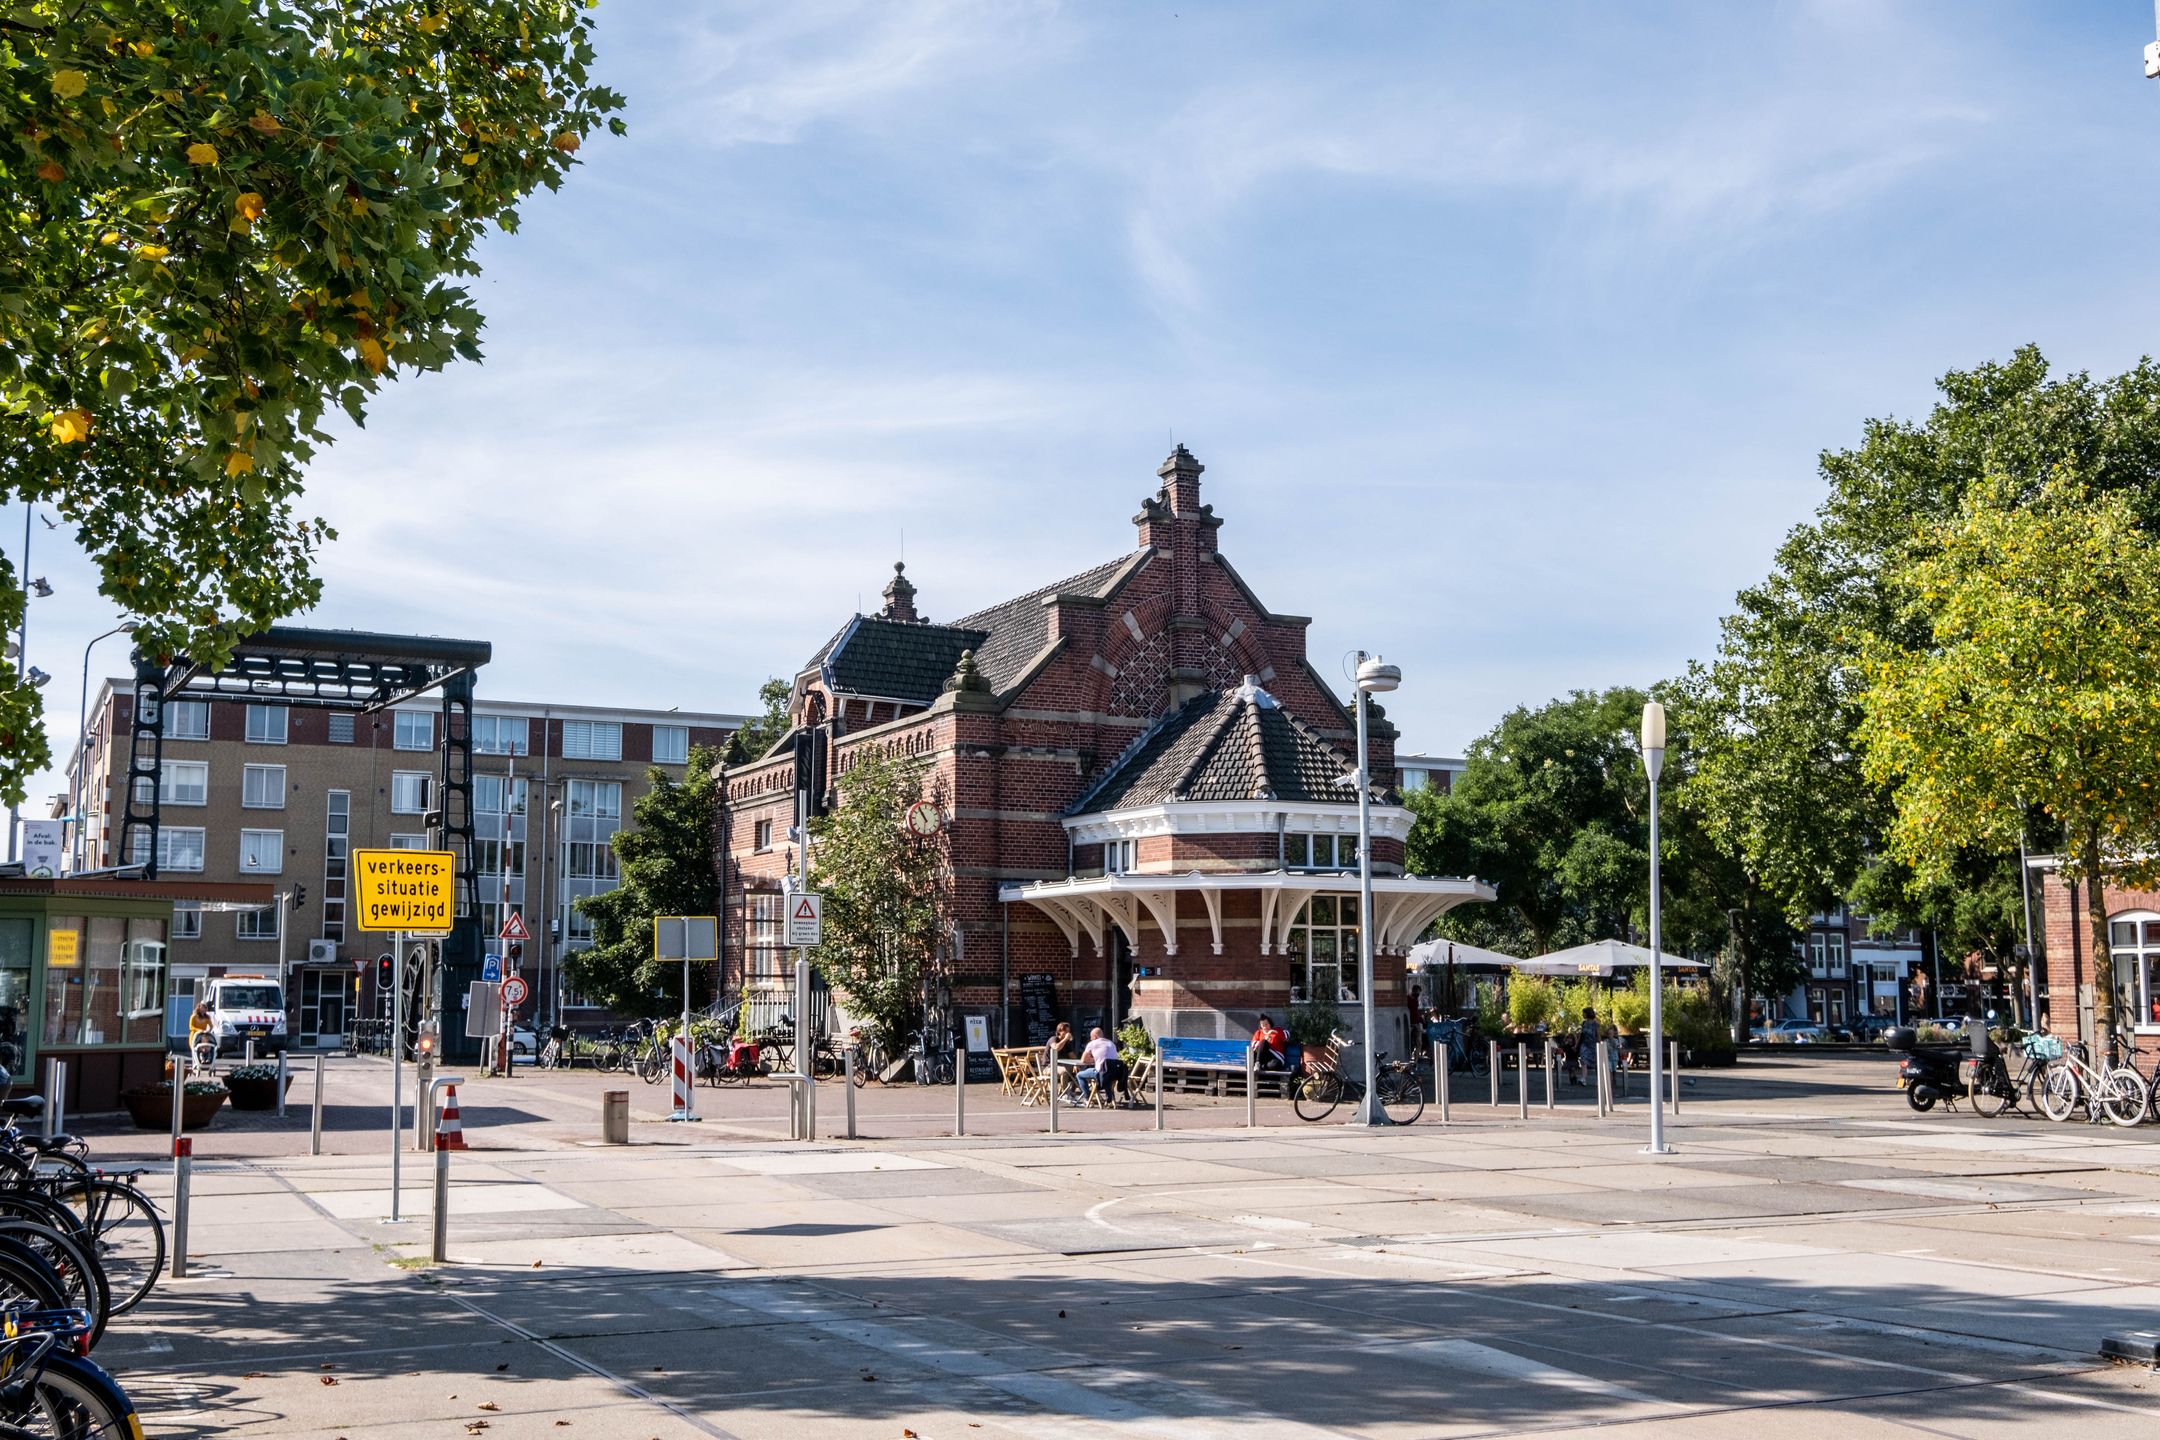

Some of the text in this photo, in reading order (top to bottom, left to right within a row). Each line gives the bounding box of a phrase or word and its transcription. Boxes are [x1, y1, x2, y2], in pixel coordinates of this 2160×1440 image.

[368, 859, 445, 875] verkeers-
[377, 880, 439, 896] situatie
[371, 901, 444, 921] gewijzigd
[489, 960, 497, 970] P
